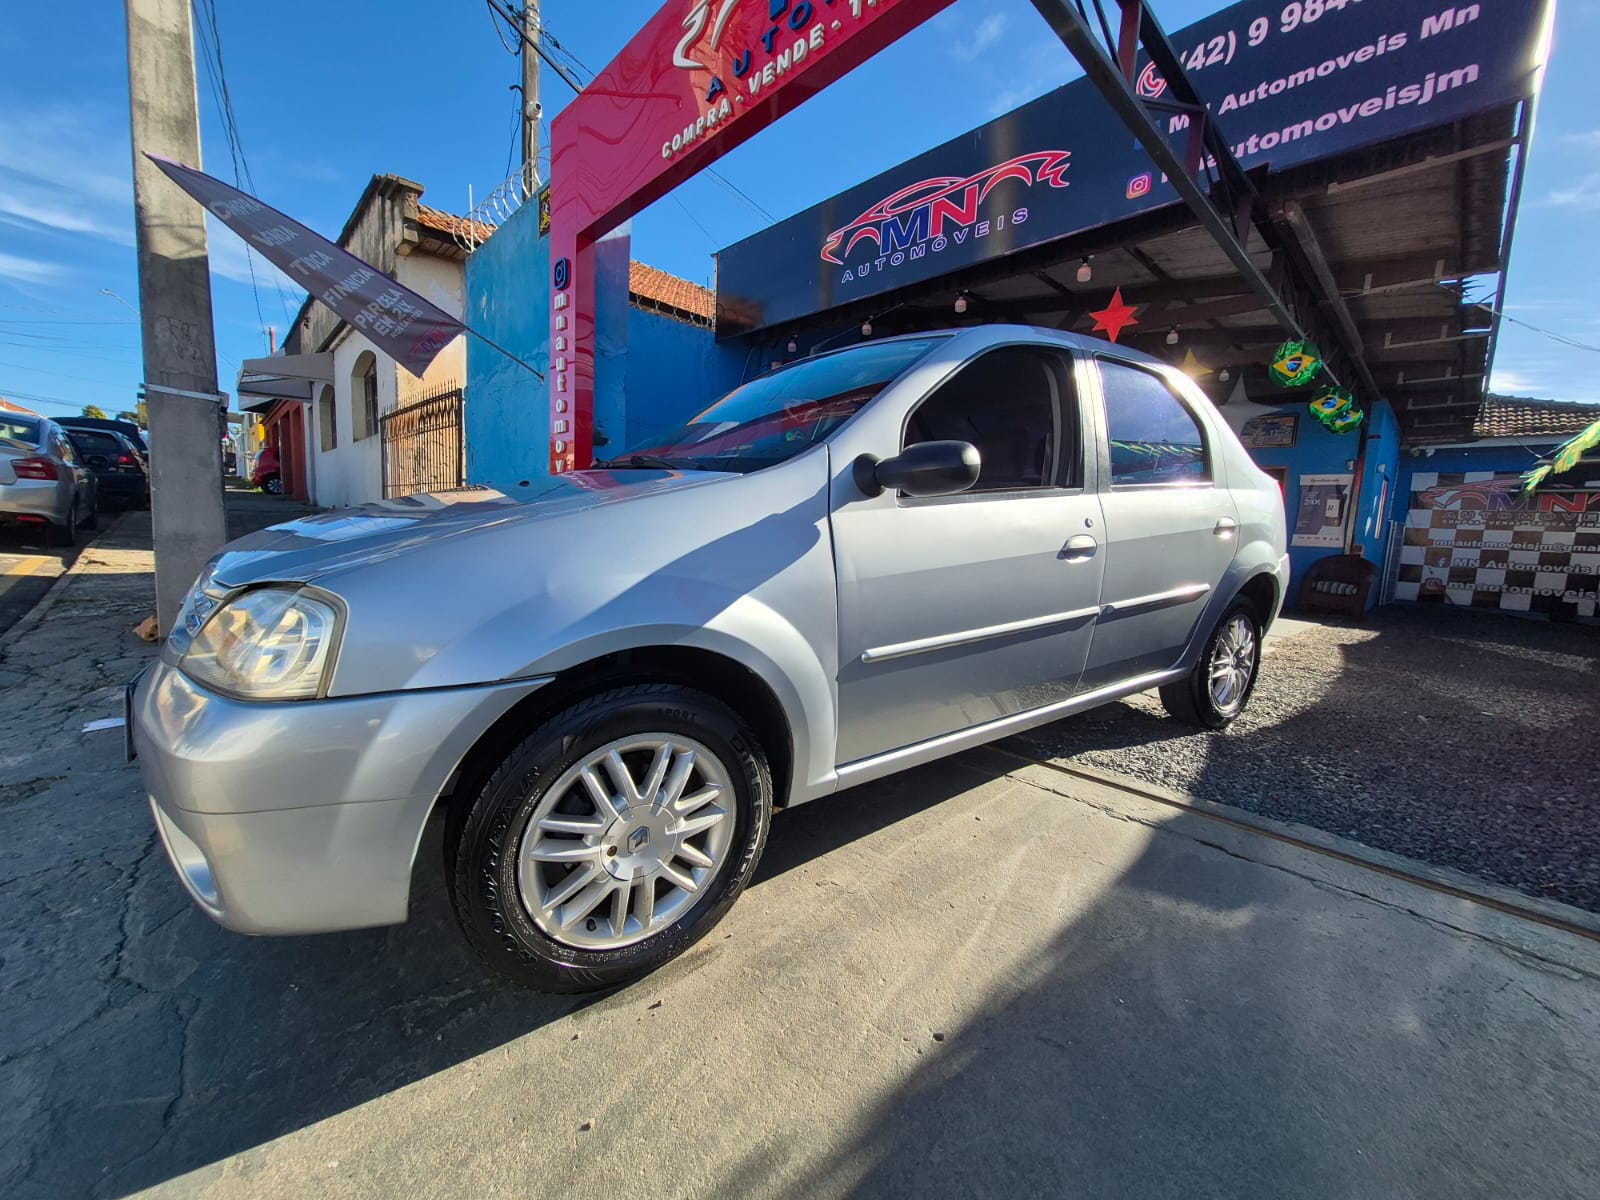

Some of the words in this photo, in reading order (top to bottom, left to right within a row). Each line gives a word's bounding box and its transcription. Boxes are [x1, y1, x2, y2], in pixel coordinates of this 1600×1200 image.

[706, 0, 835, 102] AUTO
[1247, 16, 1270, 47] 9
[1280, 0, 1363, 33] 98
[661, 98, 731, 160] COMPRA
[748, 23, 824, 95] VENDE
[849, 0, 877, 18] T
[1218, 31, 1408, 116] Automoveis
[1420, 4, 1480, 40] Mn
[841, 207, 1029, 284] AUTOMÓVEIS
[879, 184, 979, 256] MN
[354, 287, 404, 330] PARCELA
[372, 314, 397, 337] EM
[1486, 491, 1589, 513] MN
[1454, 558, 1480, 569] MN
[1486, 560, 1592, 575] Automoveis
